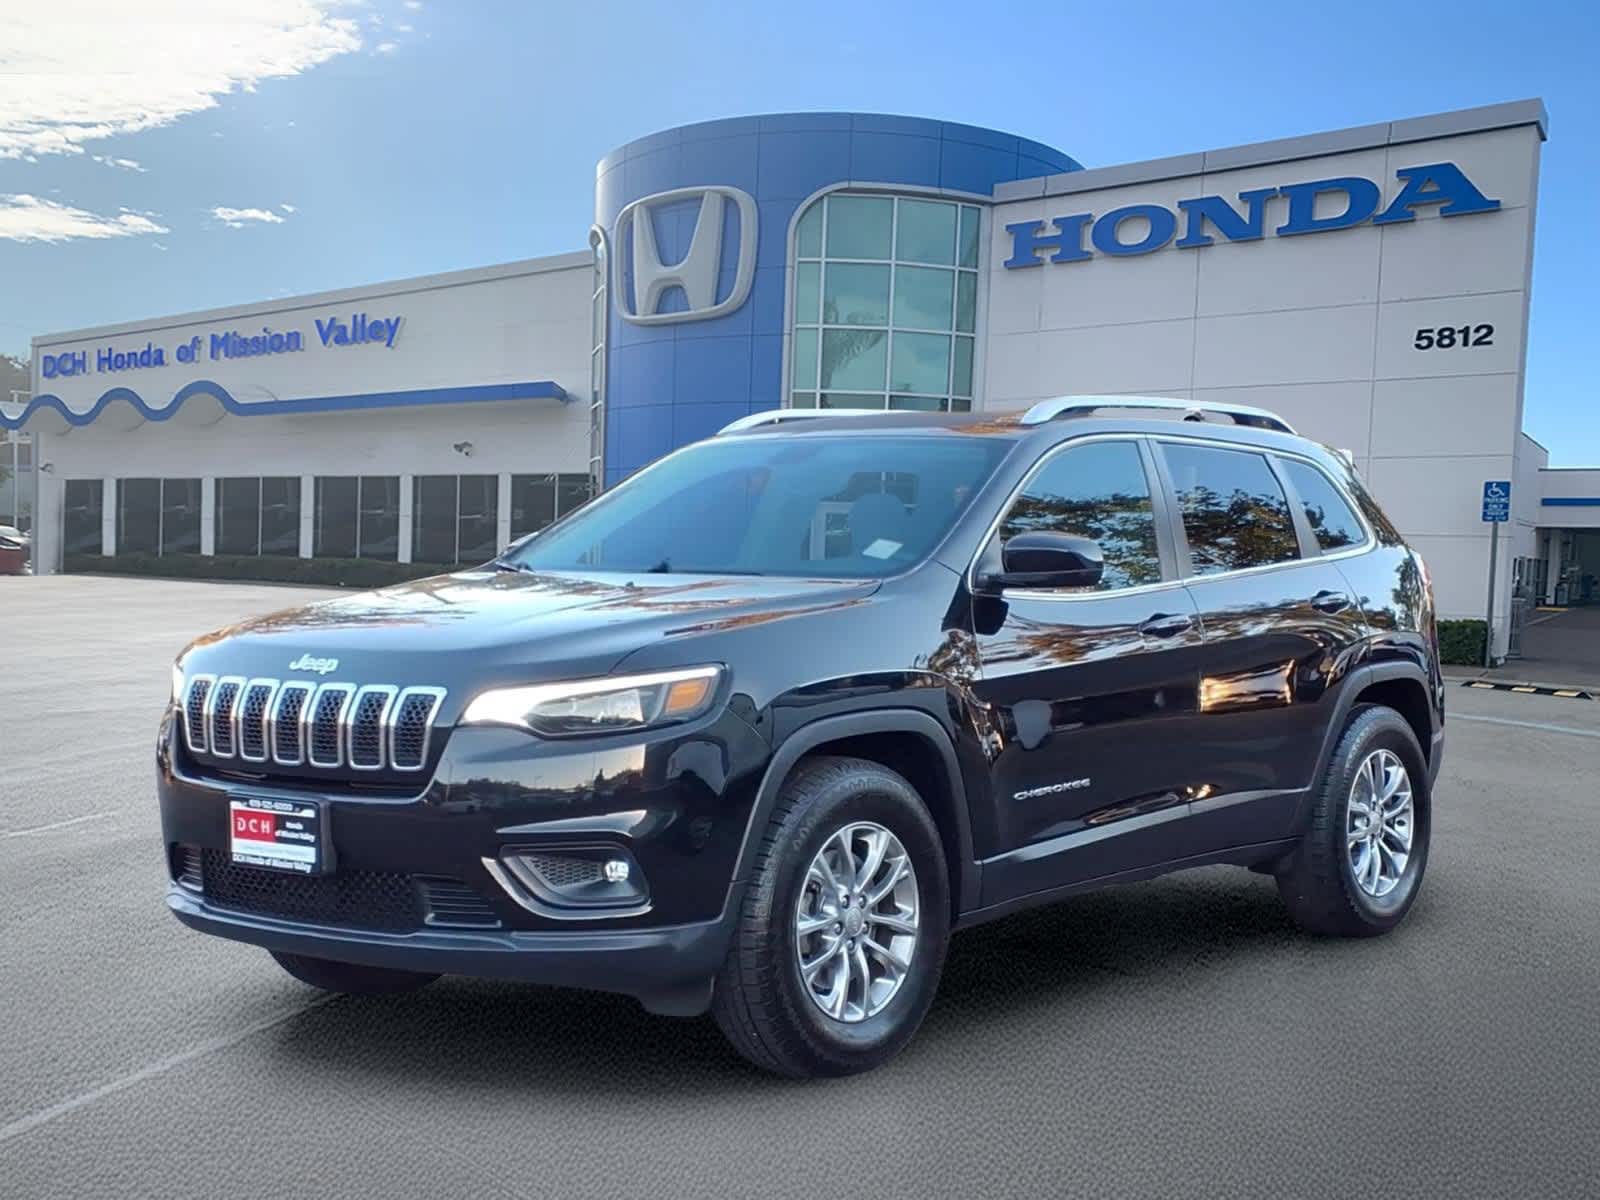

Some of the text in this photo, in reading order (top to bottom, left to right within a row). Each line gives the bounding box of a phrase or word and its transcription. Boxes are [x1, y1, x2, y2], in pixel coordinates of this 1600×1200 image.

[1003, 162, 1501, 269] HONDA
[42, 313, 402, 378] DCH Honda of Mission Valley
[1413, 323, 1495, 352] 5812
[289, 653, 339, 675] Jeep
[1013, 778, 1091, 801] CHEROKEE
[237, 817, 271, 834] DCH
